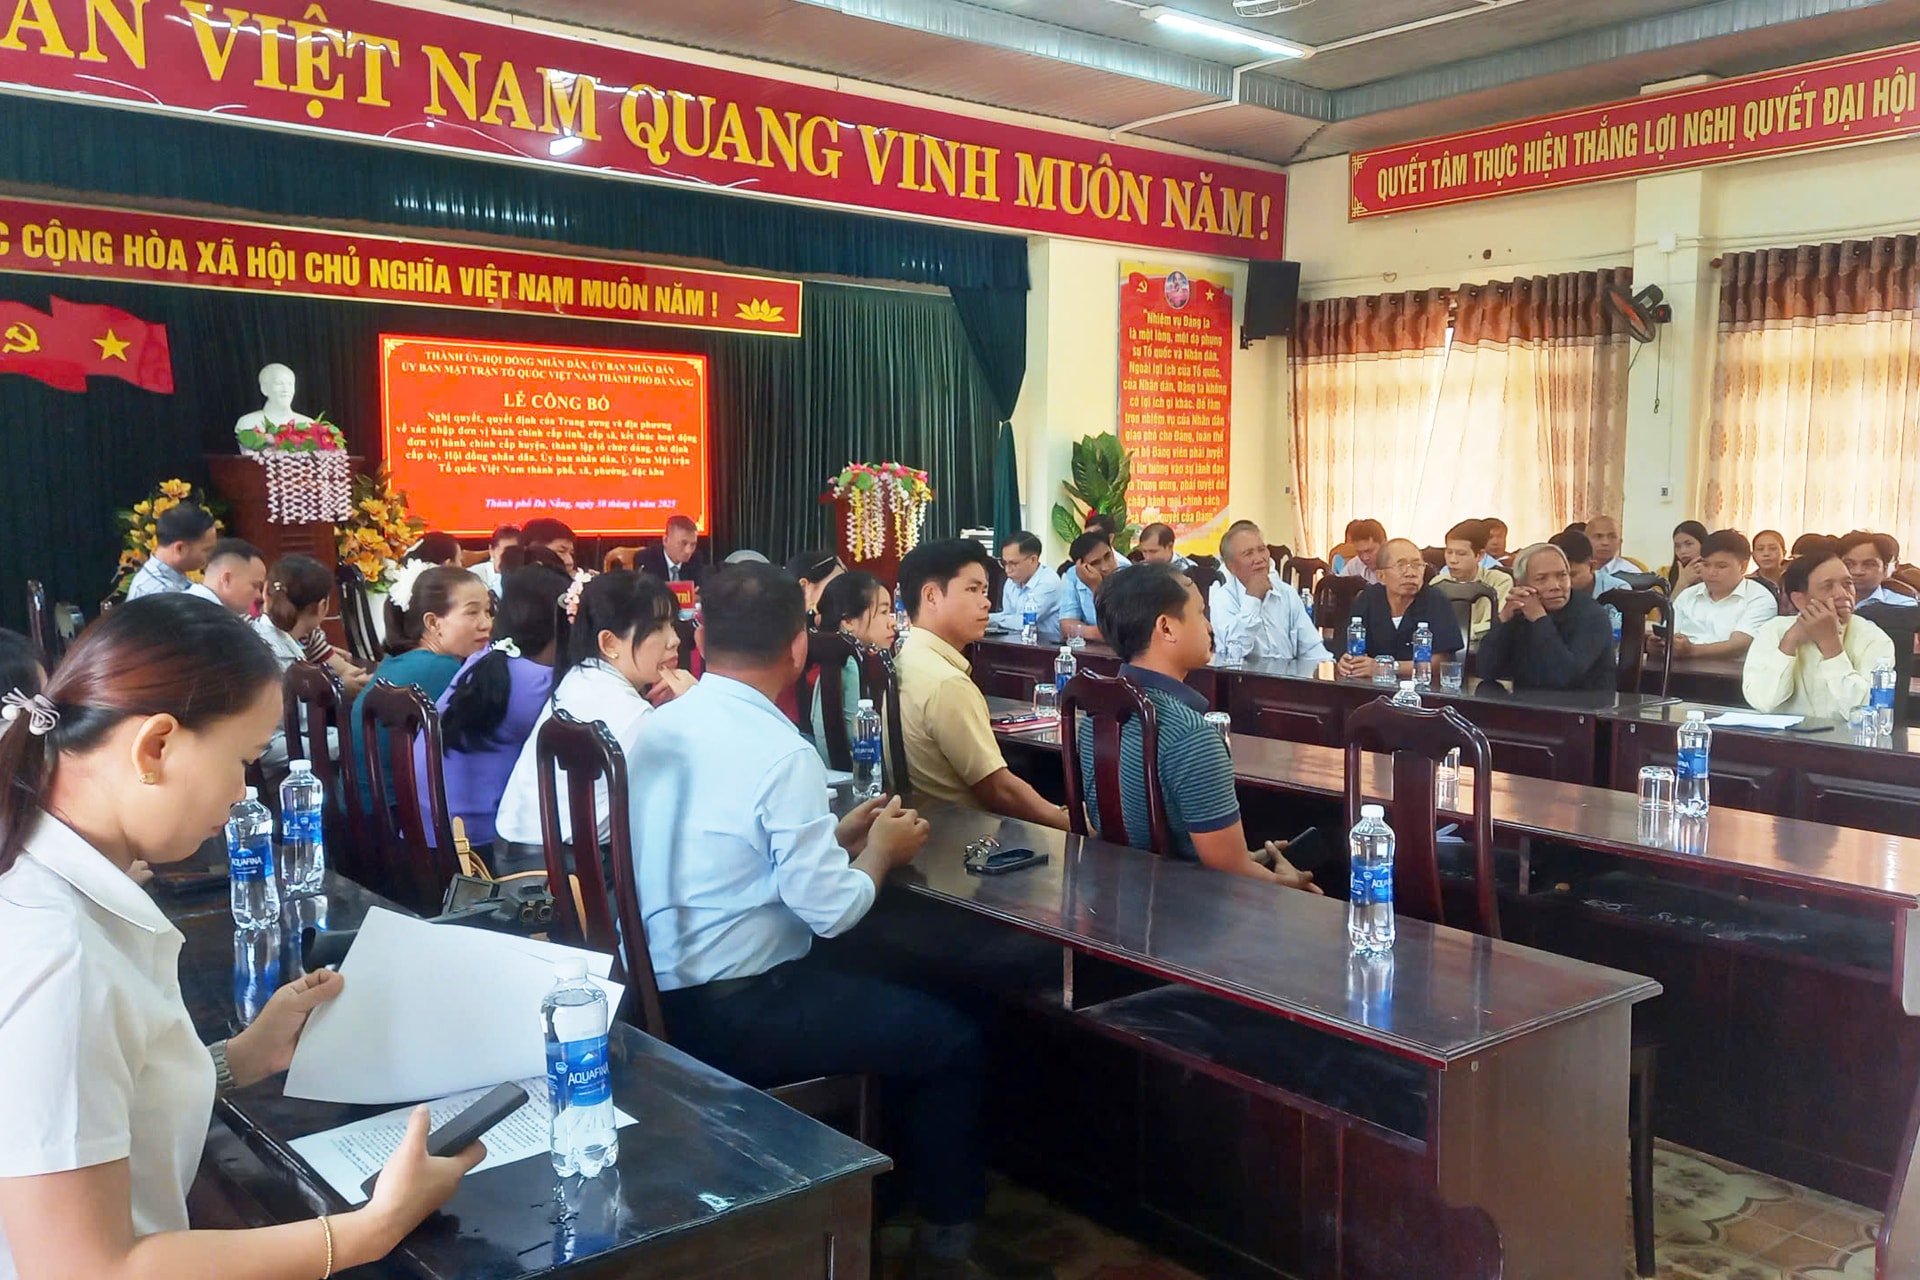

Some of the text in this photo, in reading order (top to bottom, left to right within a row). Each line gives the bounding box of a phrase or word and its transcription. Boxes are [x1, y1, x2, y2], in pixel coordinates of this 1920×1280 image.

[180, 0, 400, 118] VIỆT
[421, 45, 602, 141] NAM
[620, 84, 843, 178] QUANG
[858, 124, 1001, 202] VINH
[1014, 153, 1153, 226] MUÔN
[1377, 66, 1916, 202] QUYẾT TÂM THỰC HIỆN THẮNG LỢI NGHỊ QUYẾT ĐẠI HỘI
[22, 218, 113, 267] CỘNG
[123, 229, 188, 272] HÒA
[196, 238, 239, 276] XÃ
[247, 241, 296, 286] HỘI
[305, 245, 360, 286] CHỦ
[369, 257, 452, 294] NGHĨA
[458, 263, 512, 303] VIỆT
[518, 273, 573, 305] NAM
[581, 276, 648, 312] MUÔN
[655, 281, 704, 317] NĂM
[531, 392, 581, 410] CÔNG
